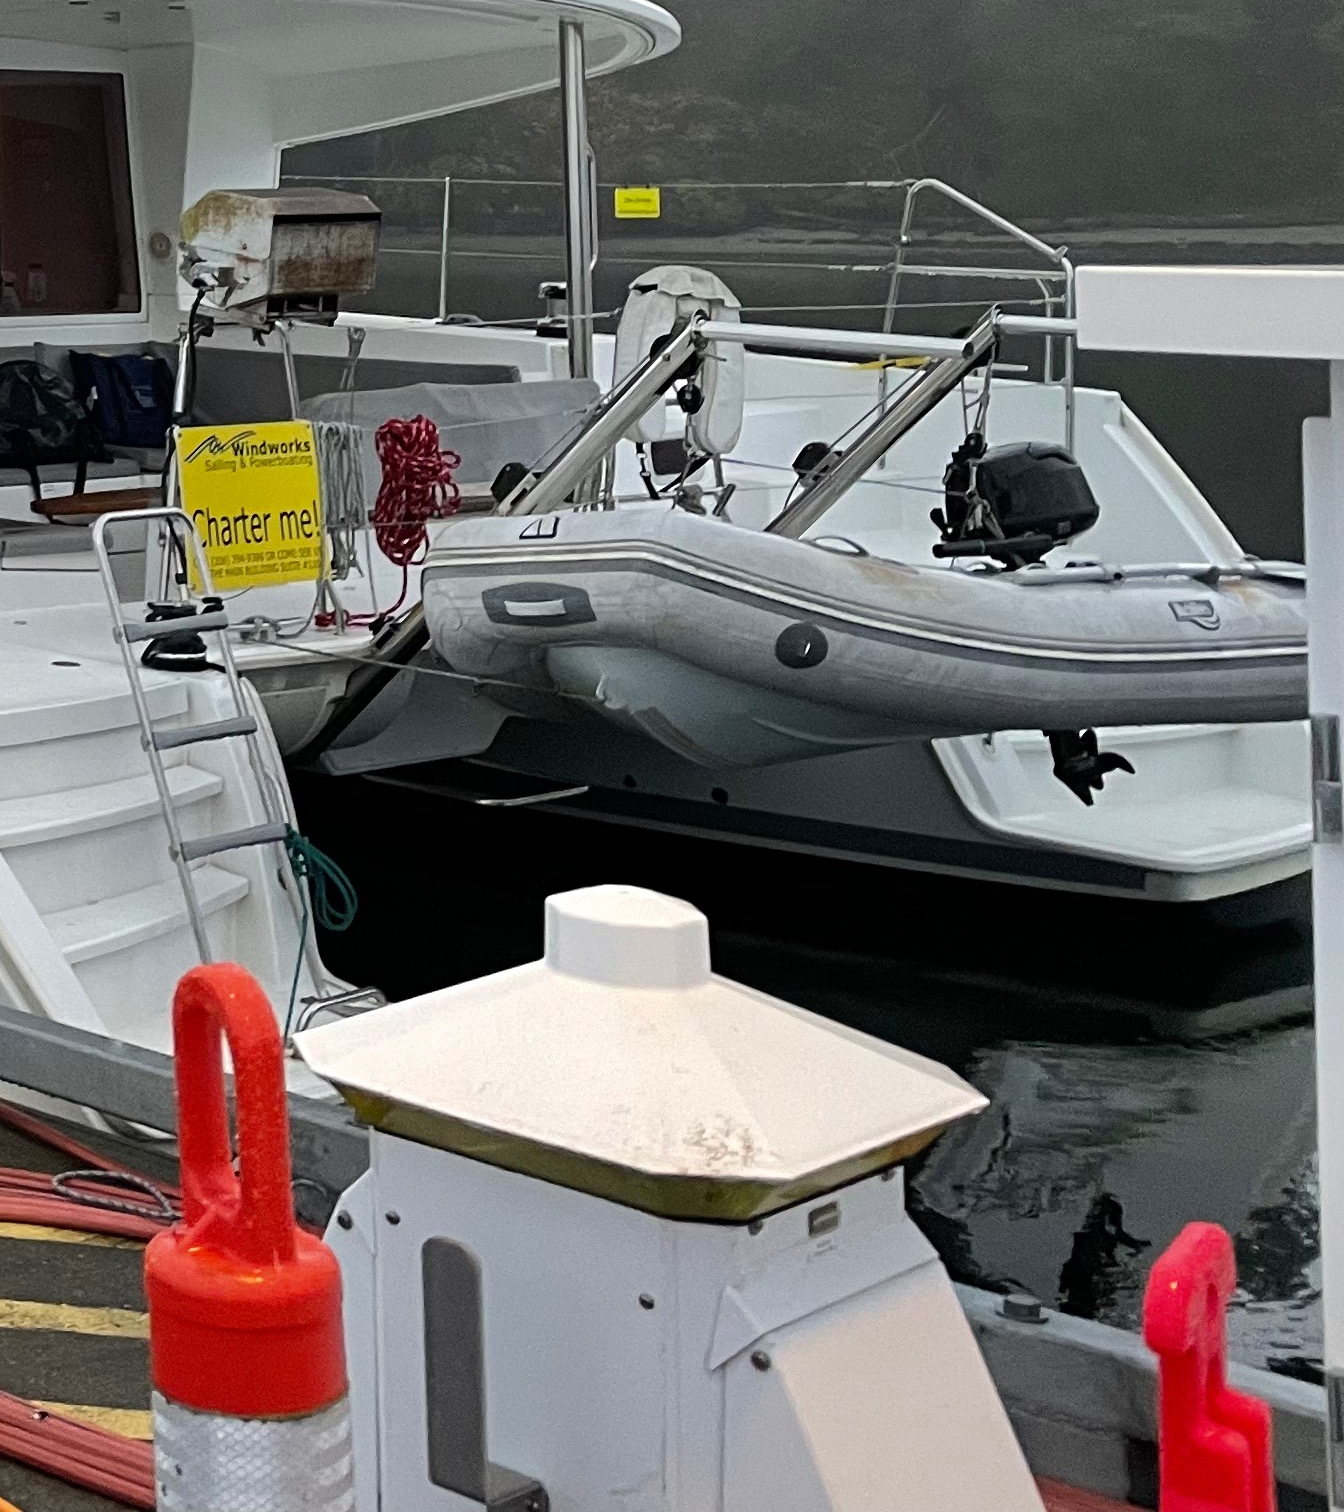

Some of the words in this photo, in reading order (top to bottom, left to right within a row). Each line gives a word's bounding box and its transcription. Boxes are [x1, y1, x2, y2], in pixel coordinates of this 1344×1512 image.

[231, 438, 311, 456] Windworks
[192, 507, 271, 548] Charter
[280, 499, 321, 540] me!
